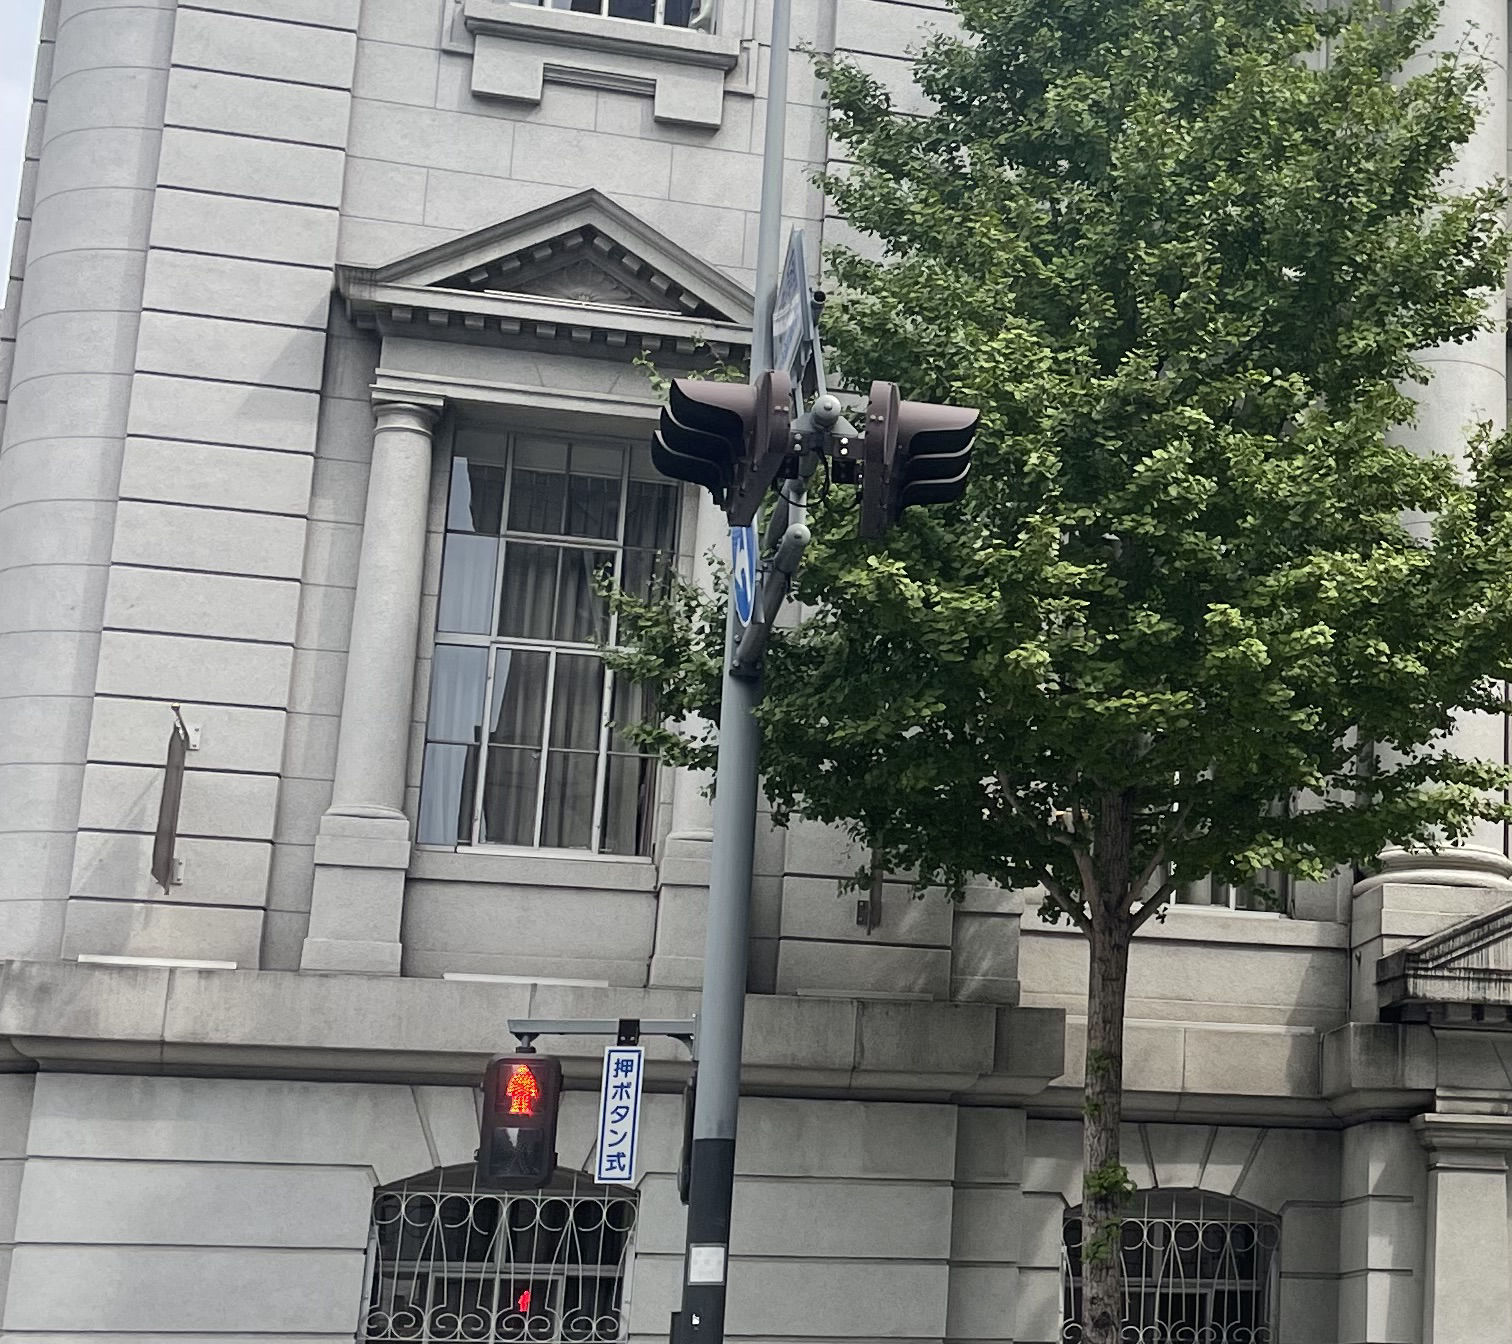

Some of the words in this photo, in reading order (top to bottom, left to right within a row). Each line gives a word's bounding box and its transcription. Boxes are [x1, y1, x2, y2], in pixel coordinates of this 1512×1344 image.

[605, 1058, 634, 1172] 押ボタン式
